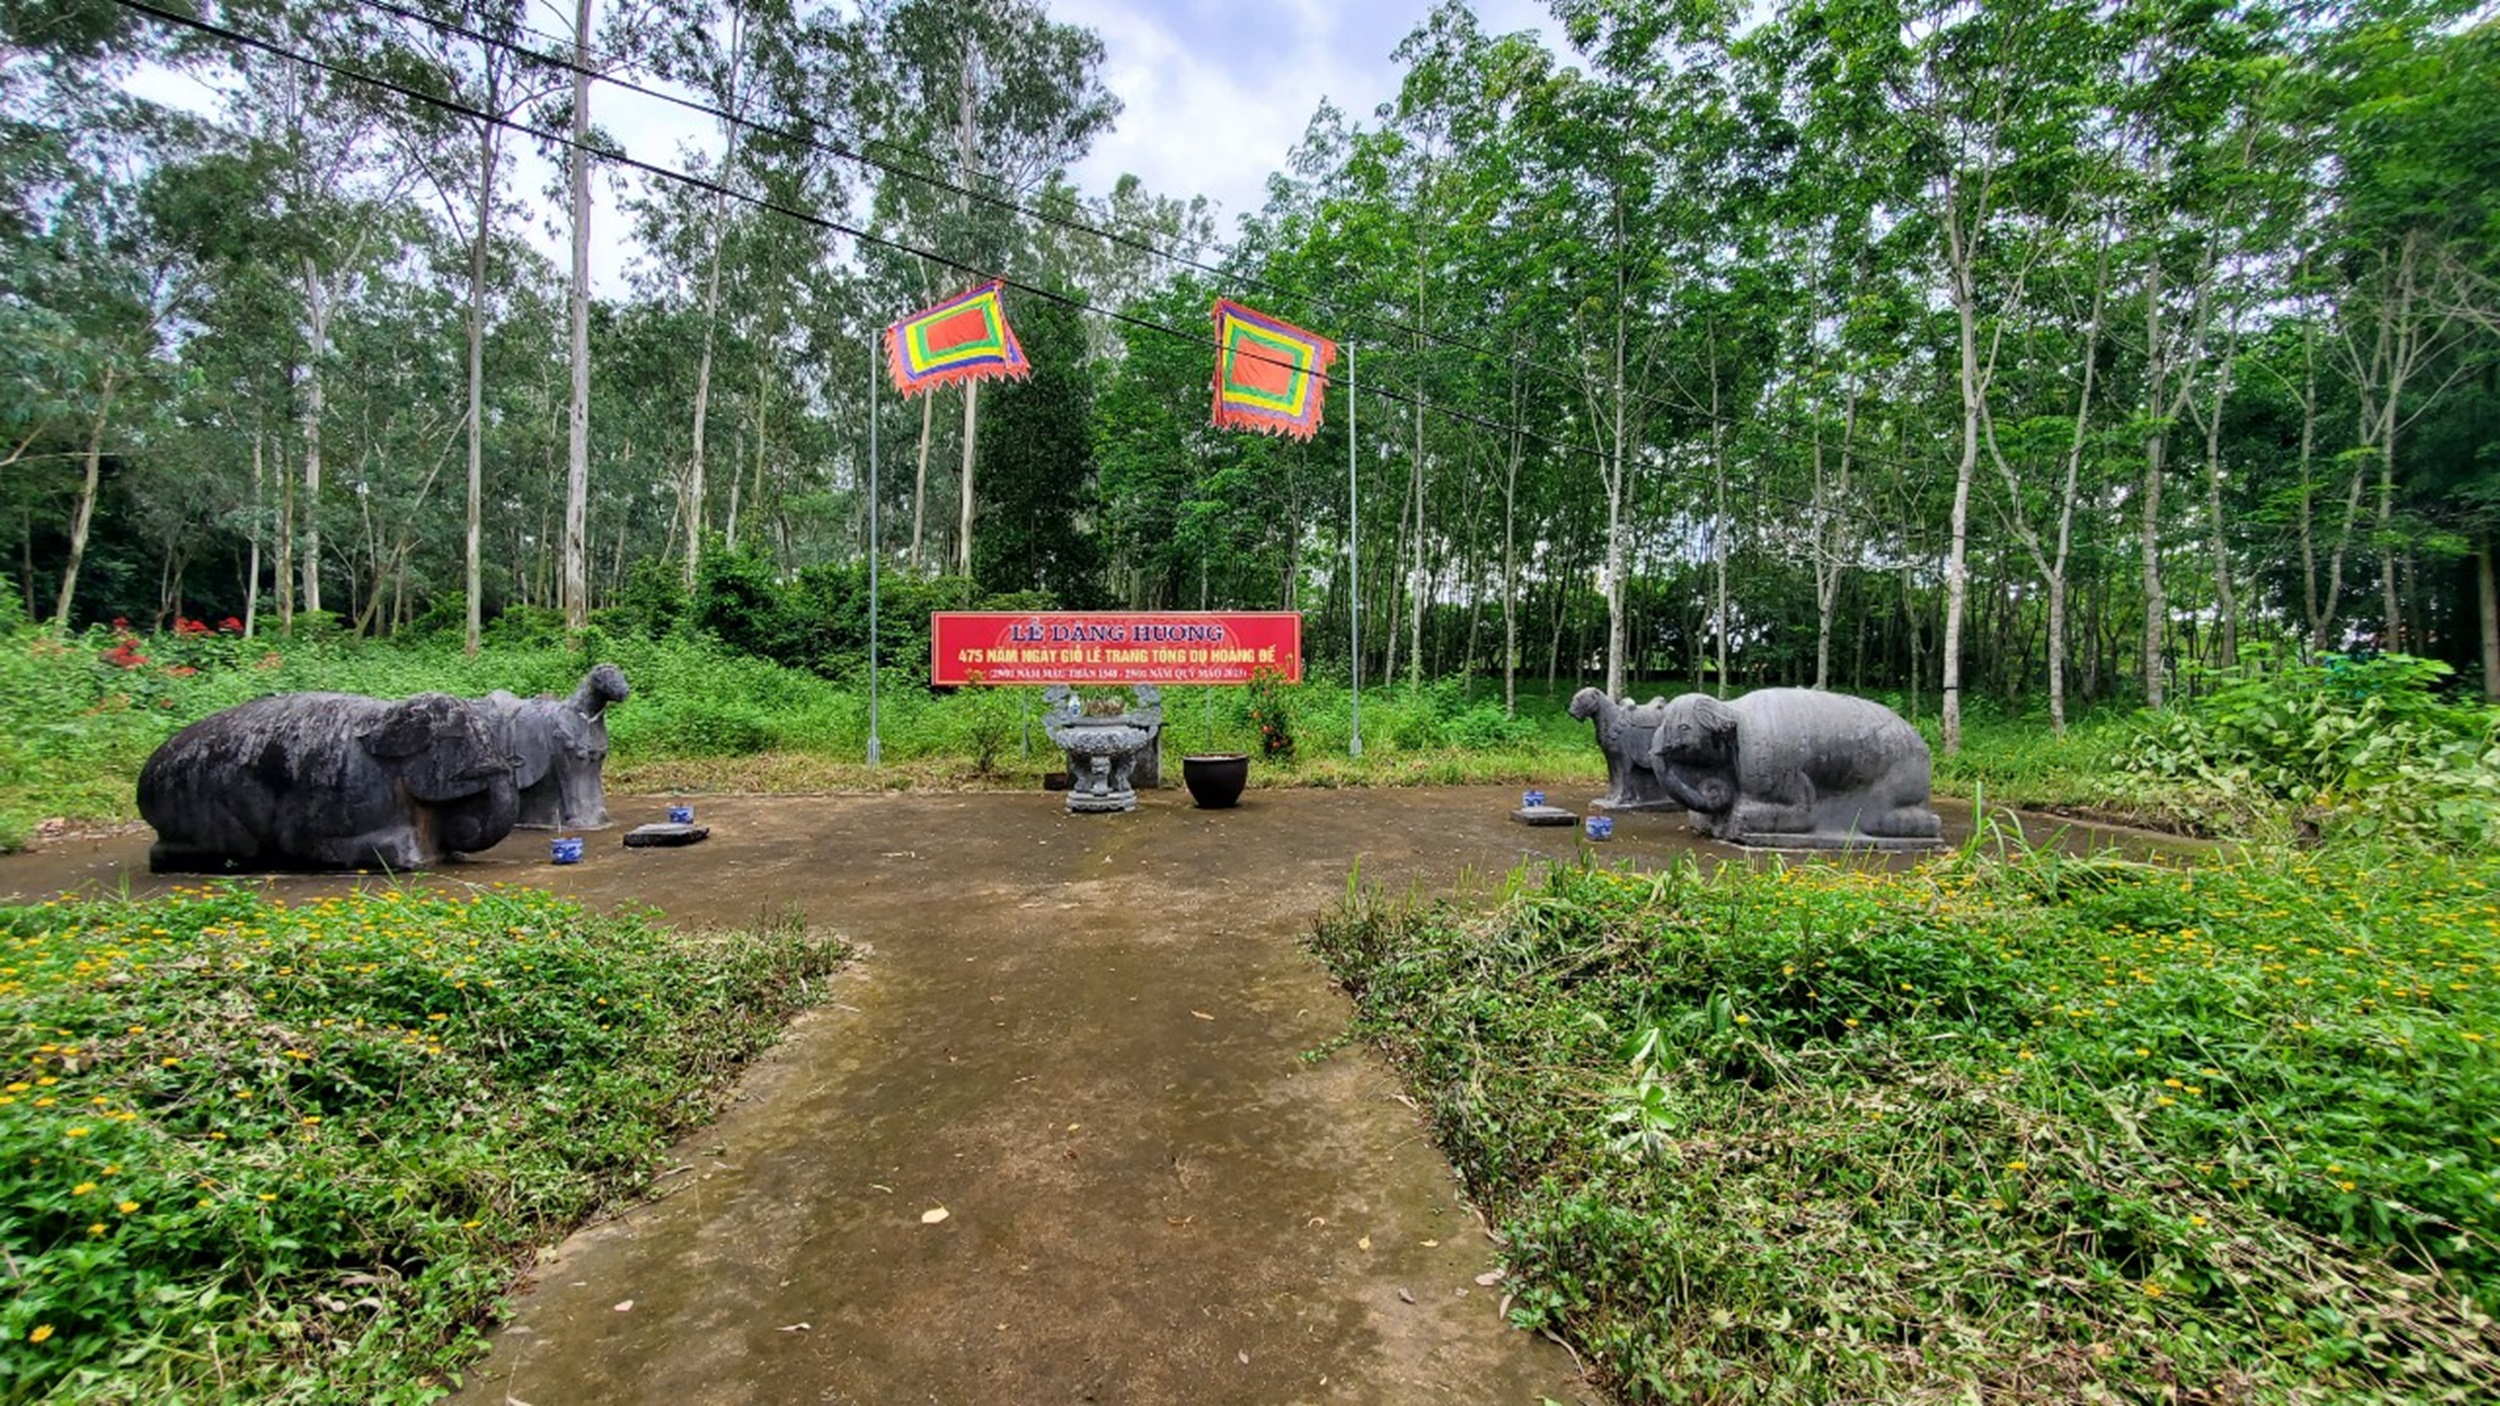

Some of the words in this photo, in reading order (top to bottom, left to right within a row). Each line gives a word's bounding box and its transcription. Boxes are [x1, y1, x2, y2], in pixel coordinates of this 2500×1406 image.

[958, 648, 983, 663] 475
[987, 645, 1018, 663] NĂM
[1021, 646, 1057, 663] NGÀY
[1086, 645, 1102, 663] LÊ
[1105, 648, 1148, 663] TRANG
[1152, 645, 1186, 663] TÔNG
[1189, 648, 1208, 665] DỤ
[1211, 645, 1255, 663] HOÀNG
[1258, 643, 1277, 663] ĐẾ
